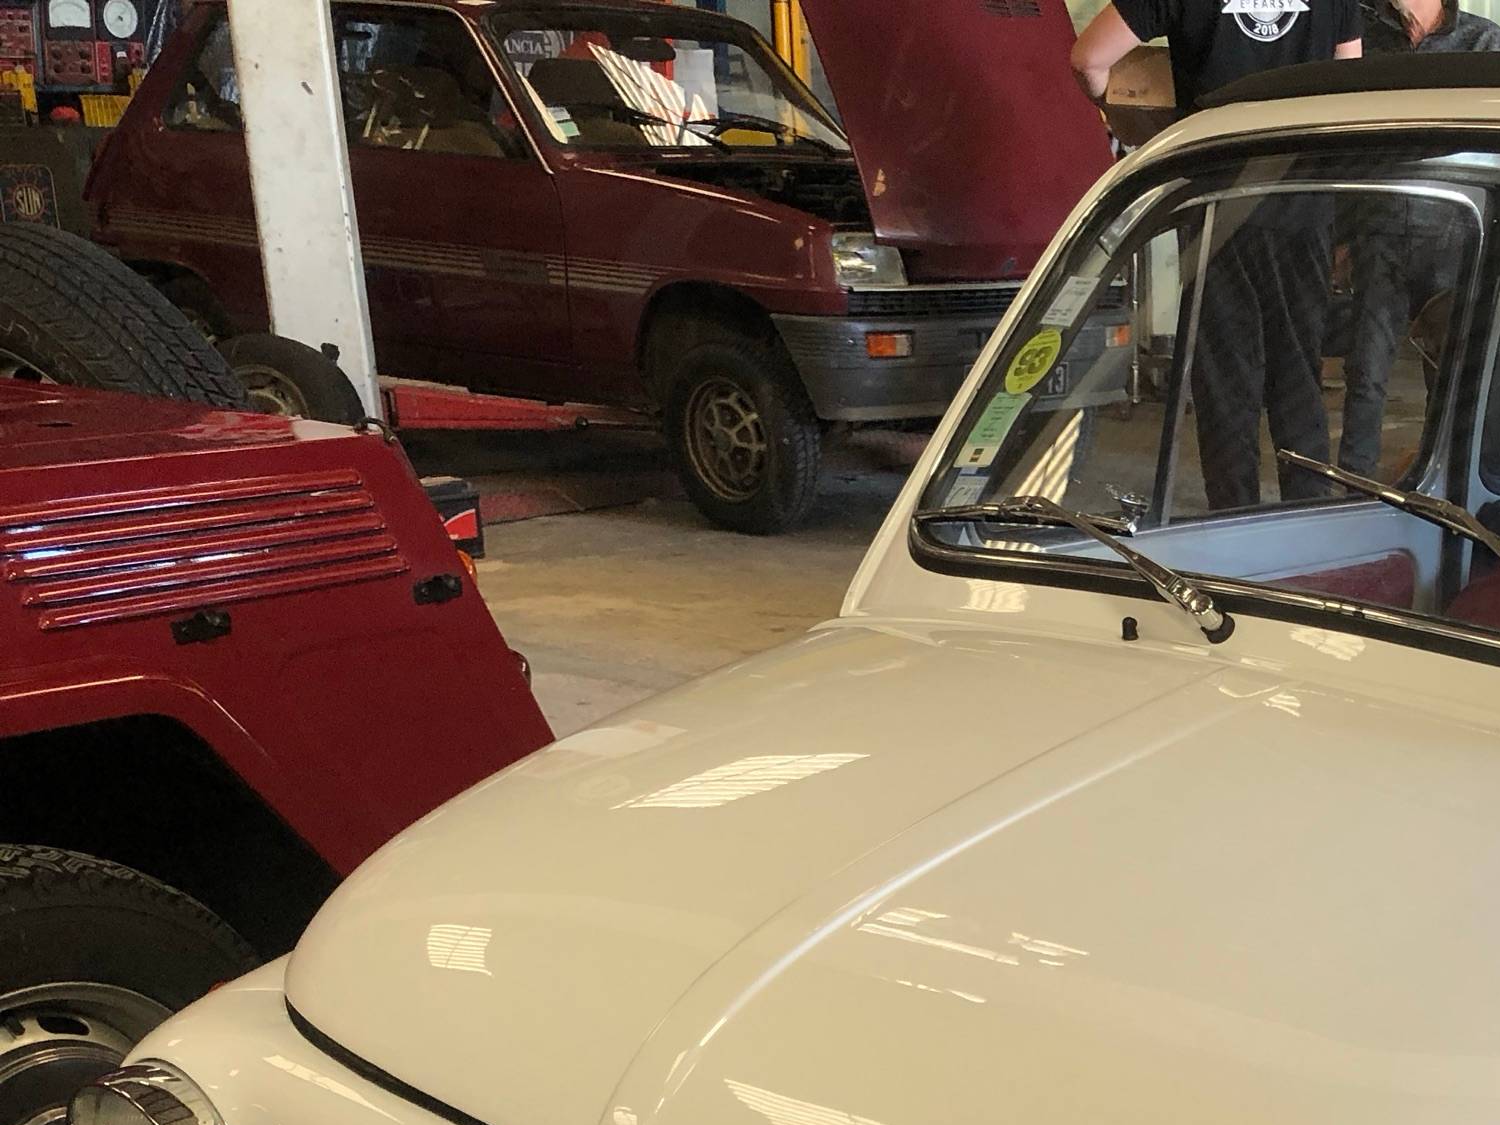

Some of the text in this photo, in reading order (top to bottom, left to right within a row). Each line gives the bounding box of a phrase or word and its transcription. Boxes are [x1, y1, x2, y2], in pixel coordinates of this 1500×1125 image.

[1253, 22, 1280, 36] 2018
[503, 38, 544, 54] ANCIA
[16, 187, 41, 216] SUN
